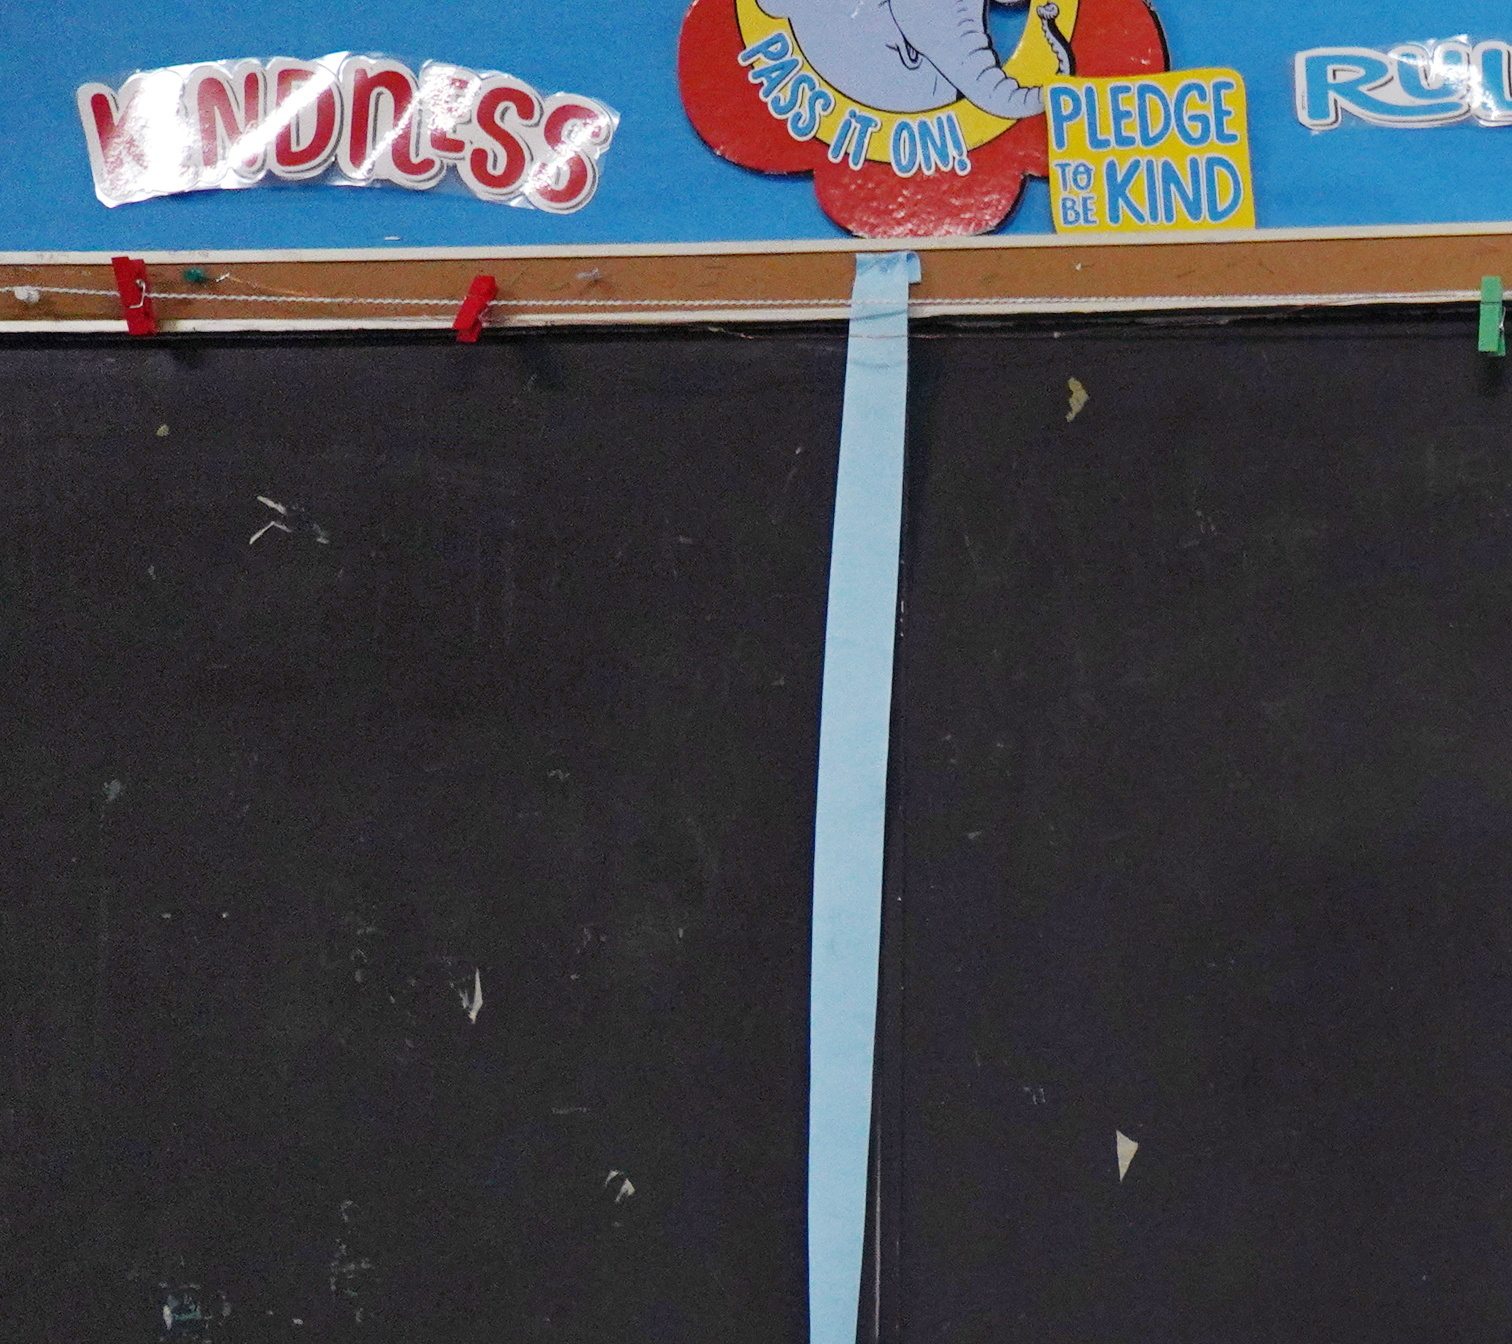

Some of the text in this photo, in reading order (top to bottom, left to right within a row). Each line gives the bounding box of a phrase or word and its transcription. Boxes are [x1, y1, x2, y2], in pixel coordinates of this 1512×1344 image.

[740, 31, 835, 142] PASS
[890, 112, 971, 178] ON!
[1049, 79, 1240, 154] PLEDGE
[1055, 160, 1096, 191] TO
[1060, 195, 1099, 228] BE
[1105, 155, 1246, 228] KIND
